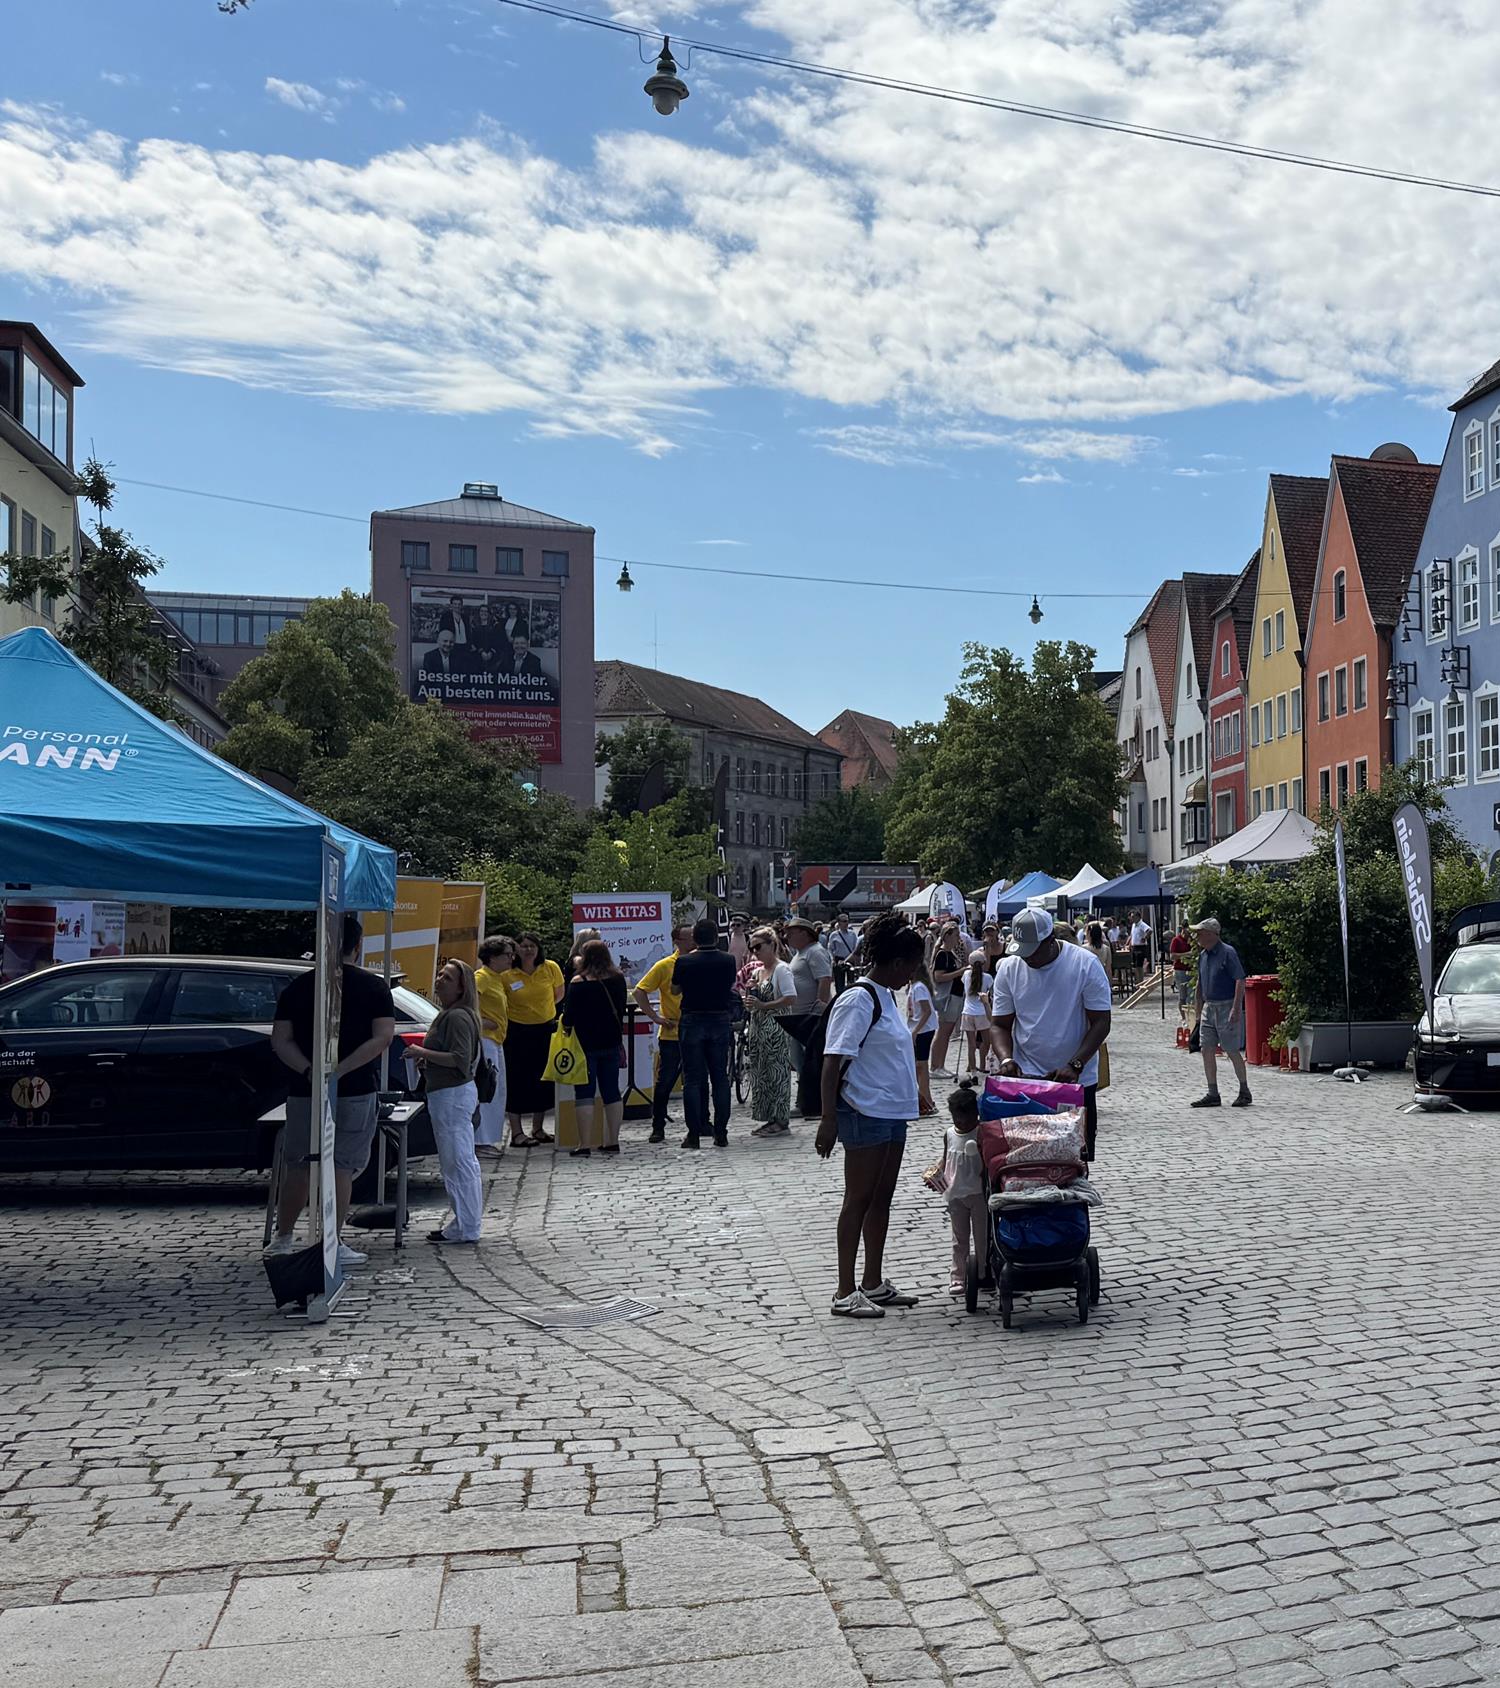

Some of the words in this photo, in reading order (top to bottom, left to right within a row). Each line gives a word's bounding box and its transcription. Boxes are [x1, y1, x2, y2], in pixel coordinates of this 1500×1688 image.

[418, 669, 467, 683] Besser
[469, 671, 494, 684] mit
[498, 673, 548, 686] Makler.
[418, 685, 441, 698] Am
[445, 685, 494, 699] besten
[498, 687, 522, 700] mit
[526, 690, 555, 701] uns.
[467, 710, 484, 718] eine
[489, 719, 507, 727] oder
[508, 719, 551, 728] vermieten?
[3, 726, 128, 745] Personal
[582, 906, 613, 919] WIR
[615, 905, 657, 918] KITAS
[618, 936, 631, 948] Sie
[633, 937, 648, 945] vor
[649, 933, 665, 943] Ort
[0, 1058, 35, 1067] schaft
